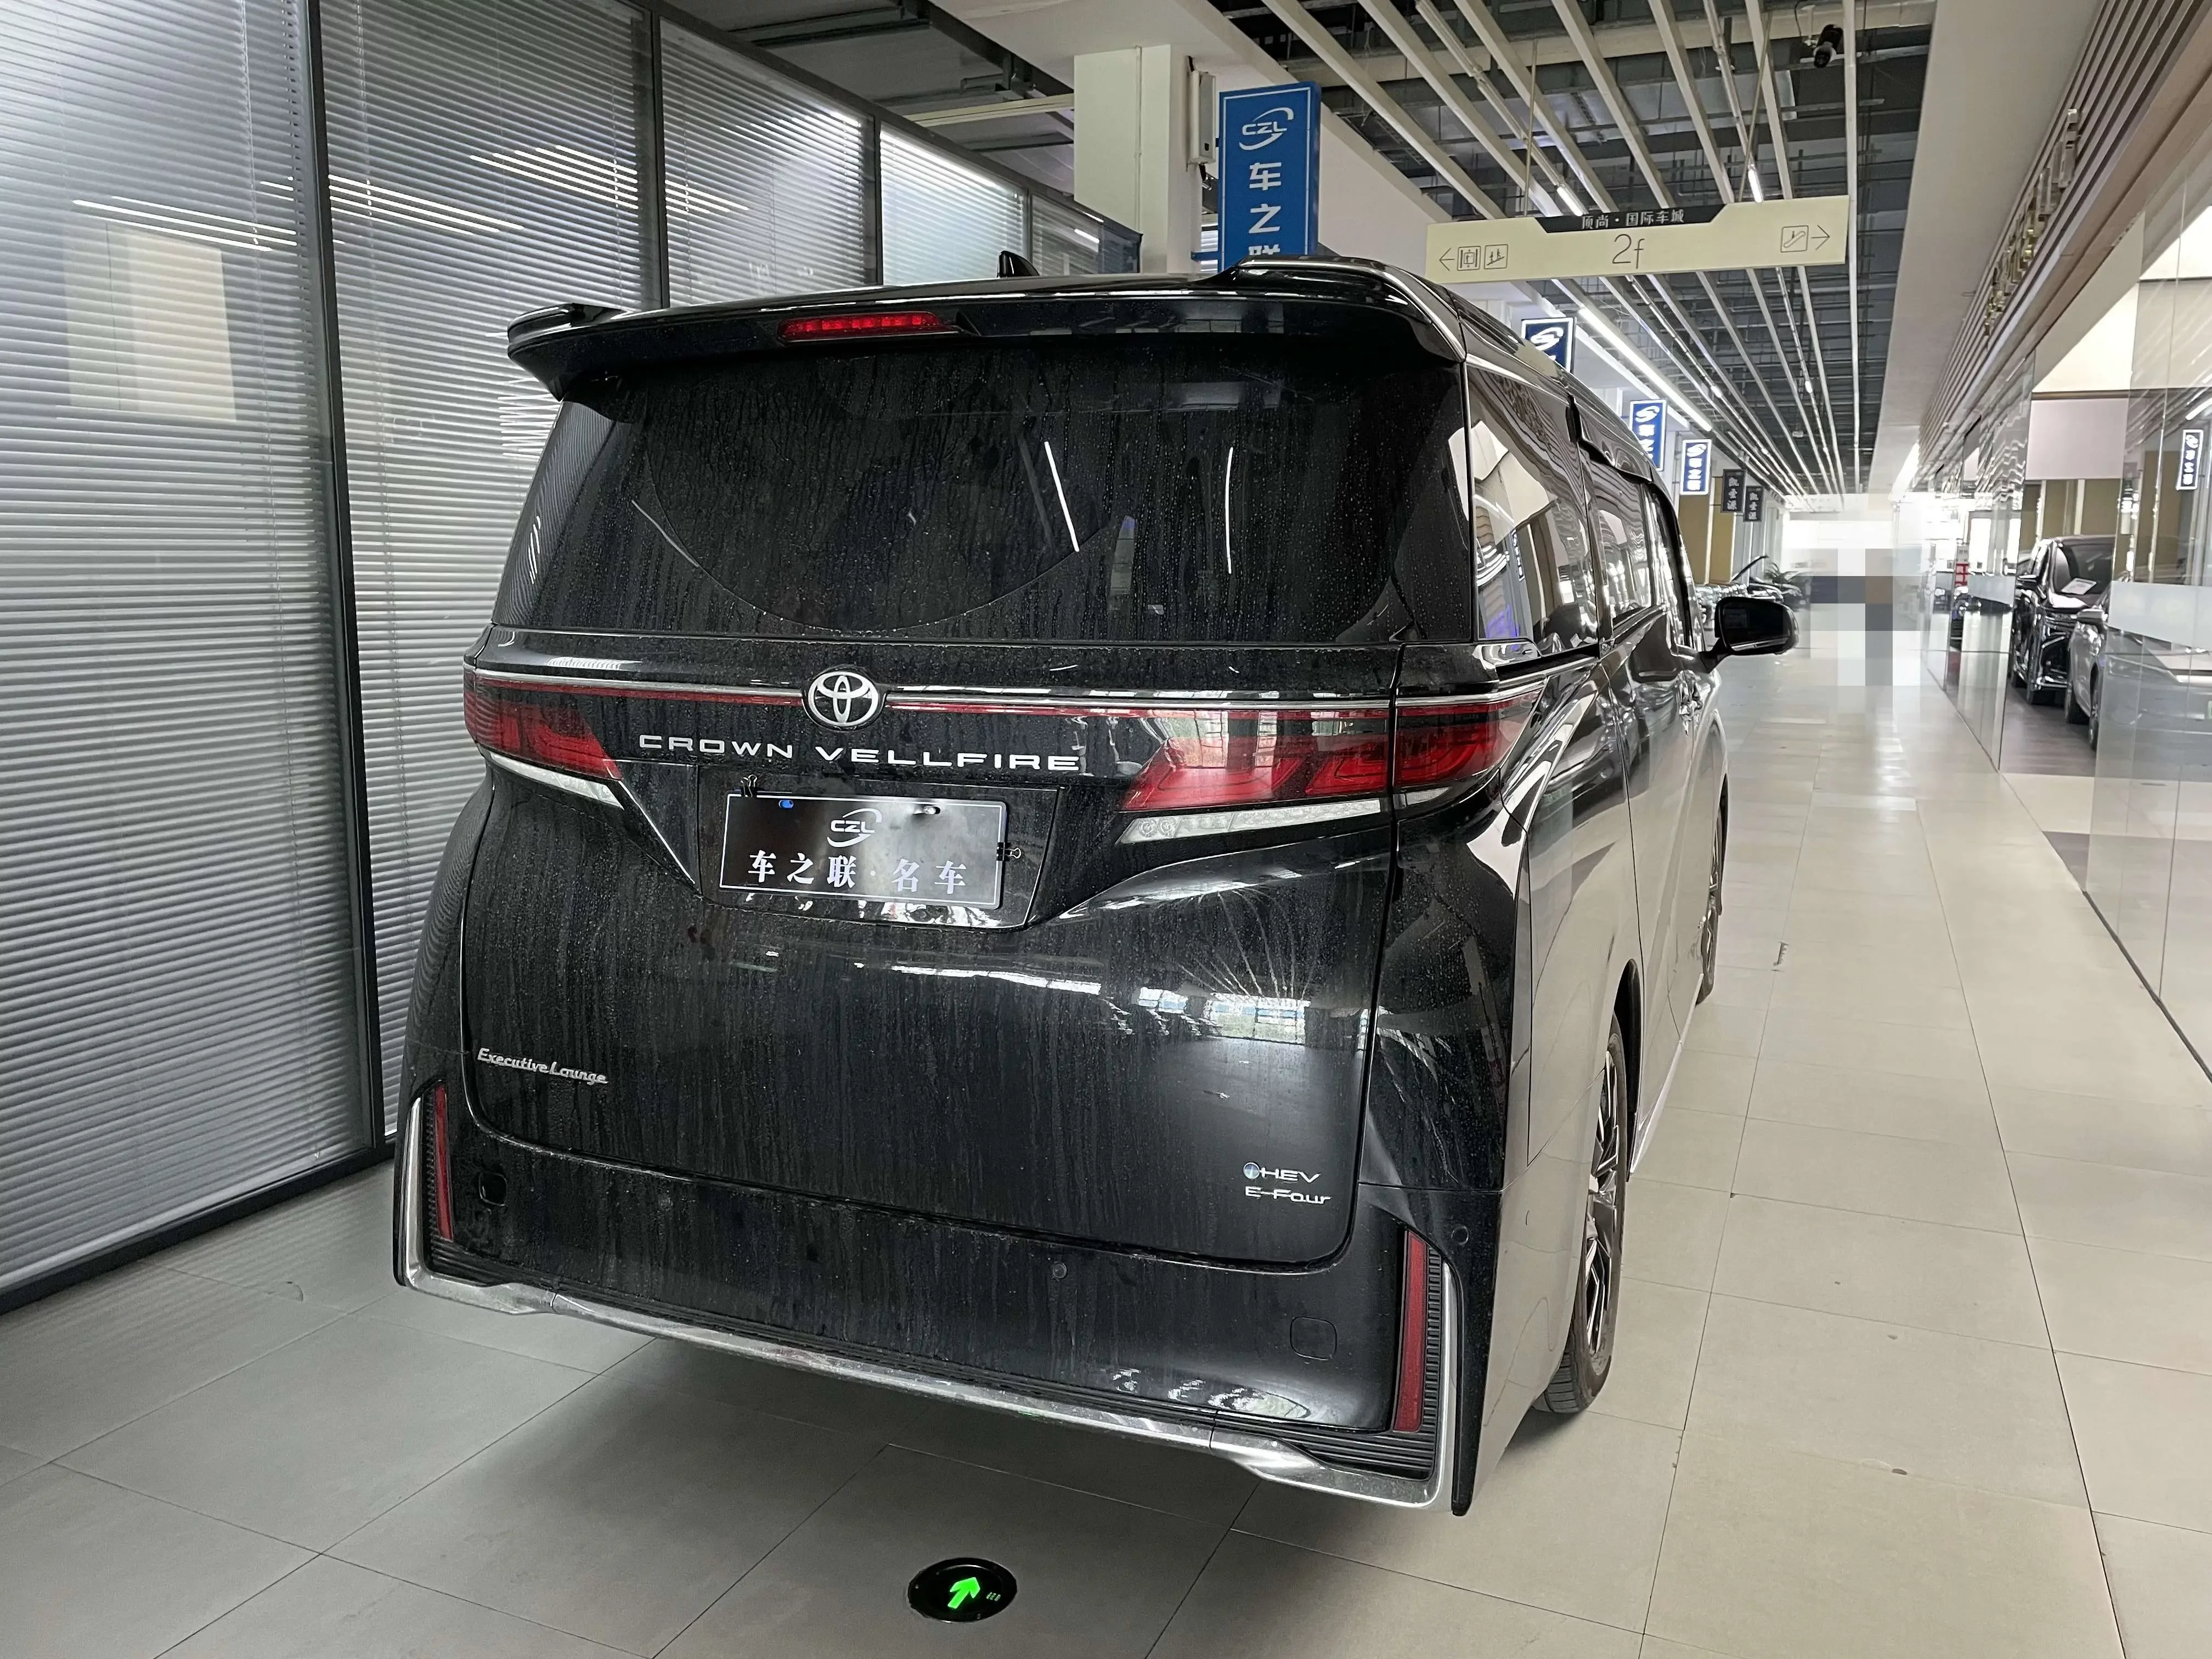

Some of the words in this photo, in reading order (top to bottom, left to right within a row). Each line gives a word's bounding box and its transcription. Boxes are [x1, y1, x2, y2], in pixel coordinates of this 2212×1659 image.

[1242, 121, 1287, 136] CZL
[1612, 234, 1645, 269] 2f
[639, 734, 793, 759] CROWN
[815, 747, 1080, 772] VELLFIRE
[831, 820, 875, 833] CZL
[477, 1047, 549, 1073] Executive
[549, 1062, 609, 1085] Lounge
[1261, 1167, 1321, 1183] HEV
[1245, 1186, 1332, 1204] E-Four
